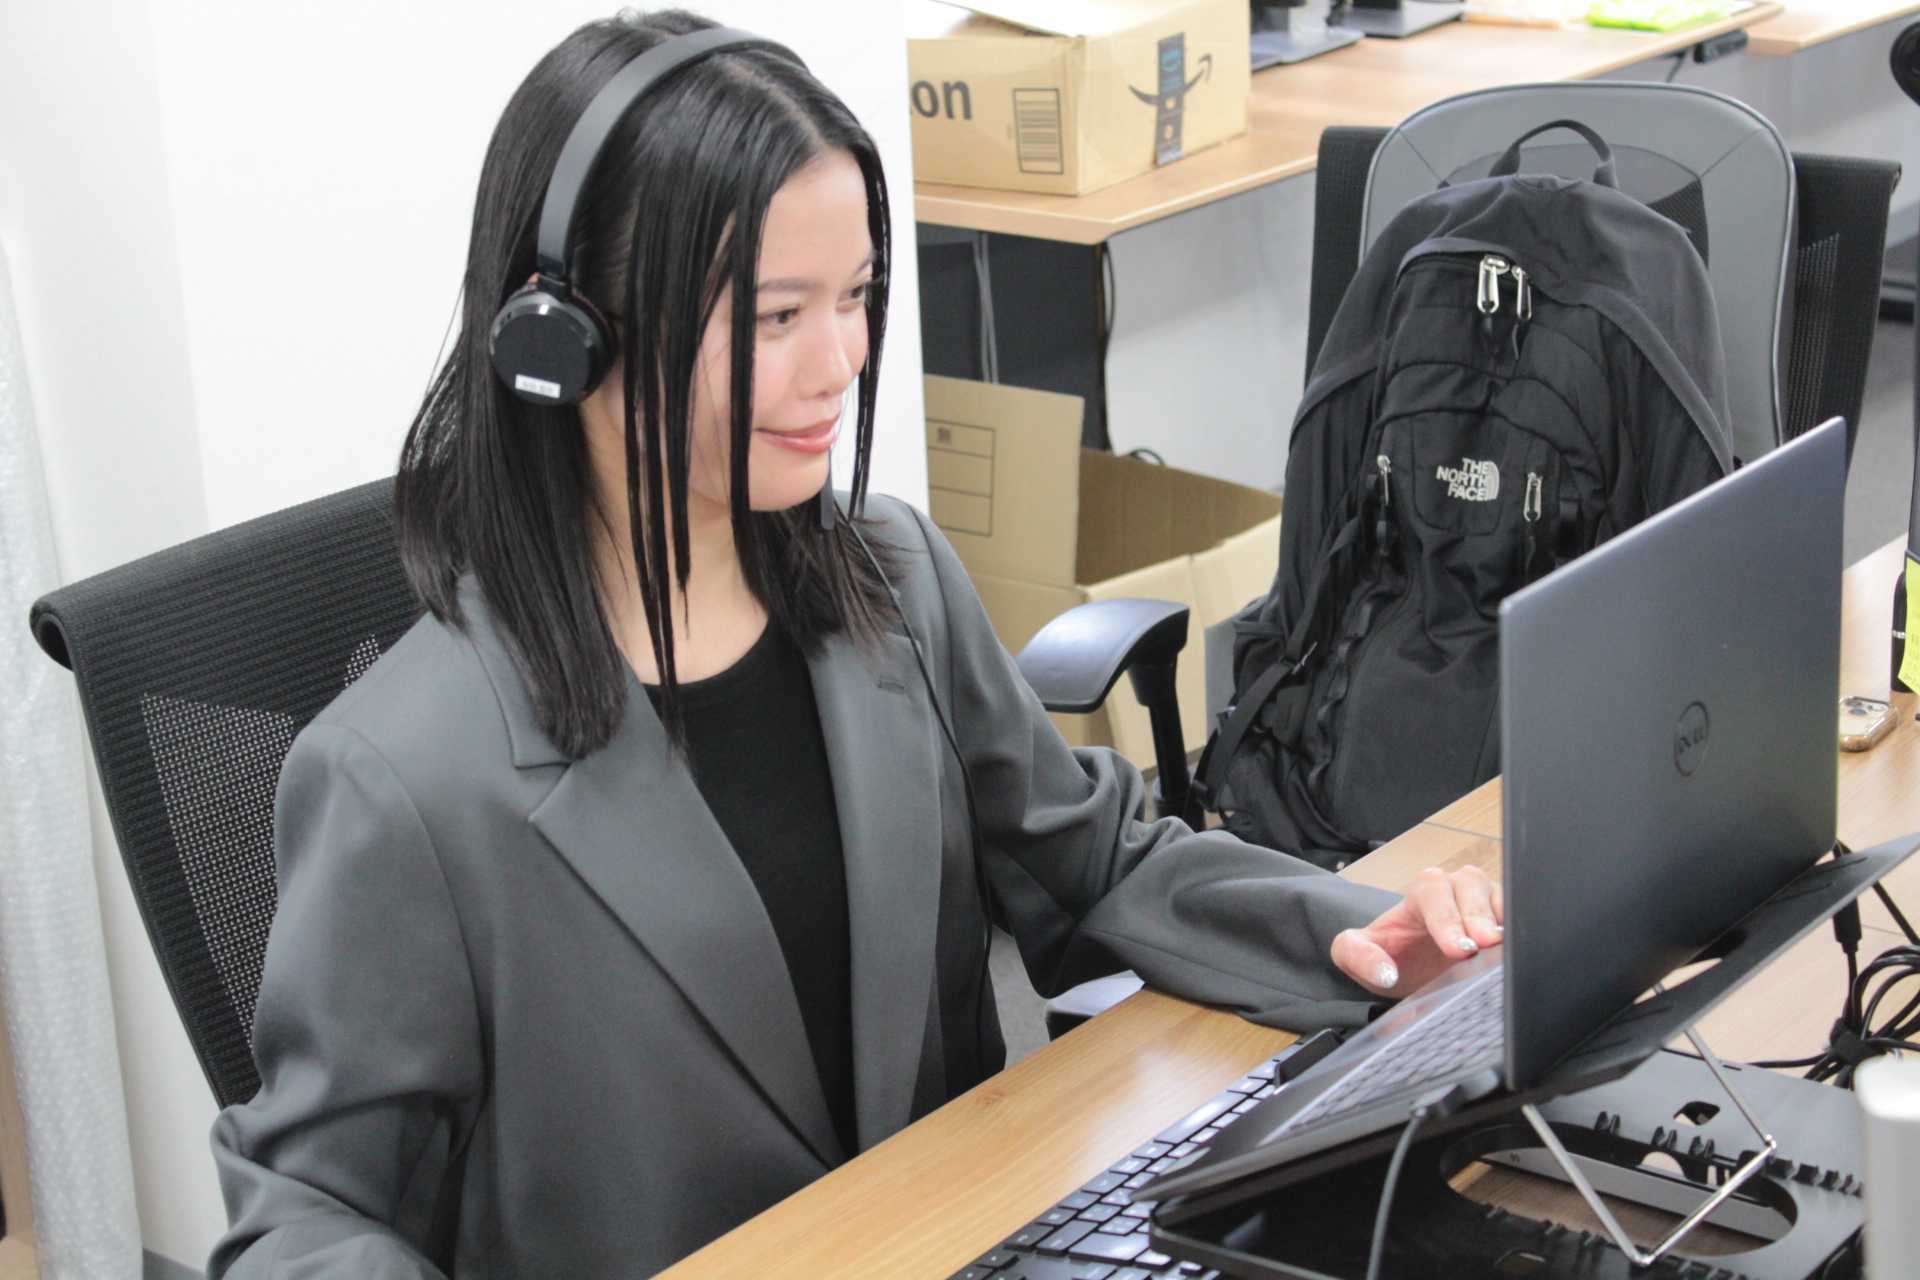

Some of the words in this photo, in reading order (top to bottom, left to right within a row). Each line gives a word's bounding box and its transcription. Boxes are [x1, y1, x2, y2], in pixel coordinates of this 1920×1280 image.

[910, 80, 972, 119] on
[1462, 457, 1488, 474] THE
[1436, 465, 1488, 488] NORTH
[1448, 482, 1487, 501] FACE
